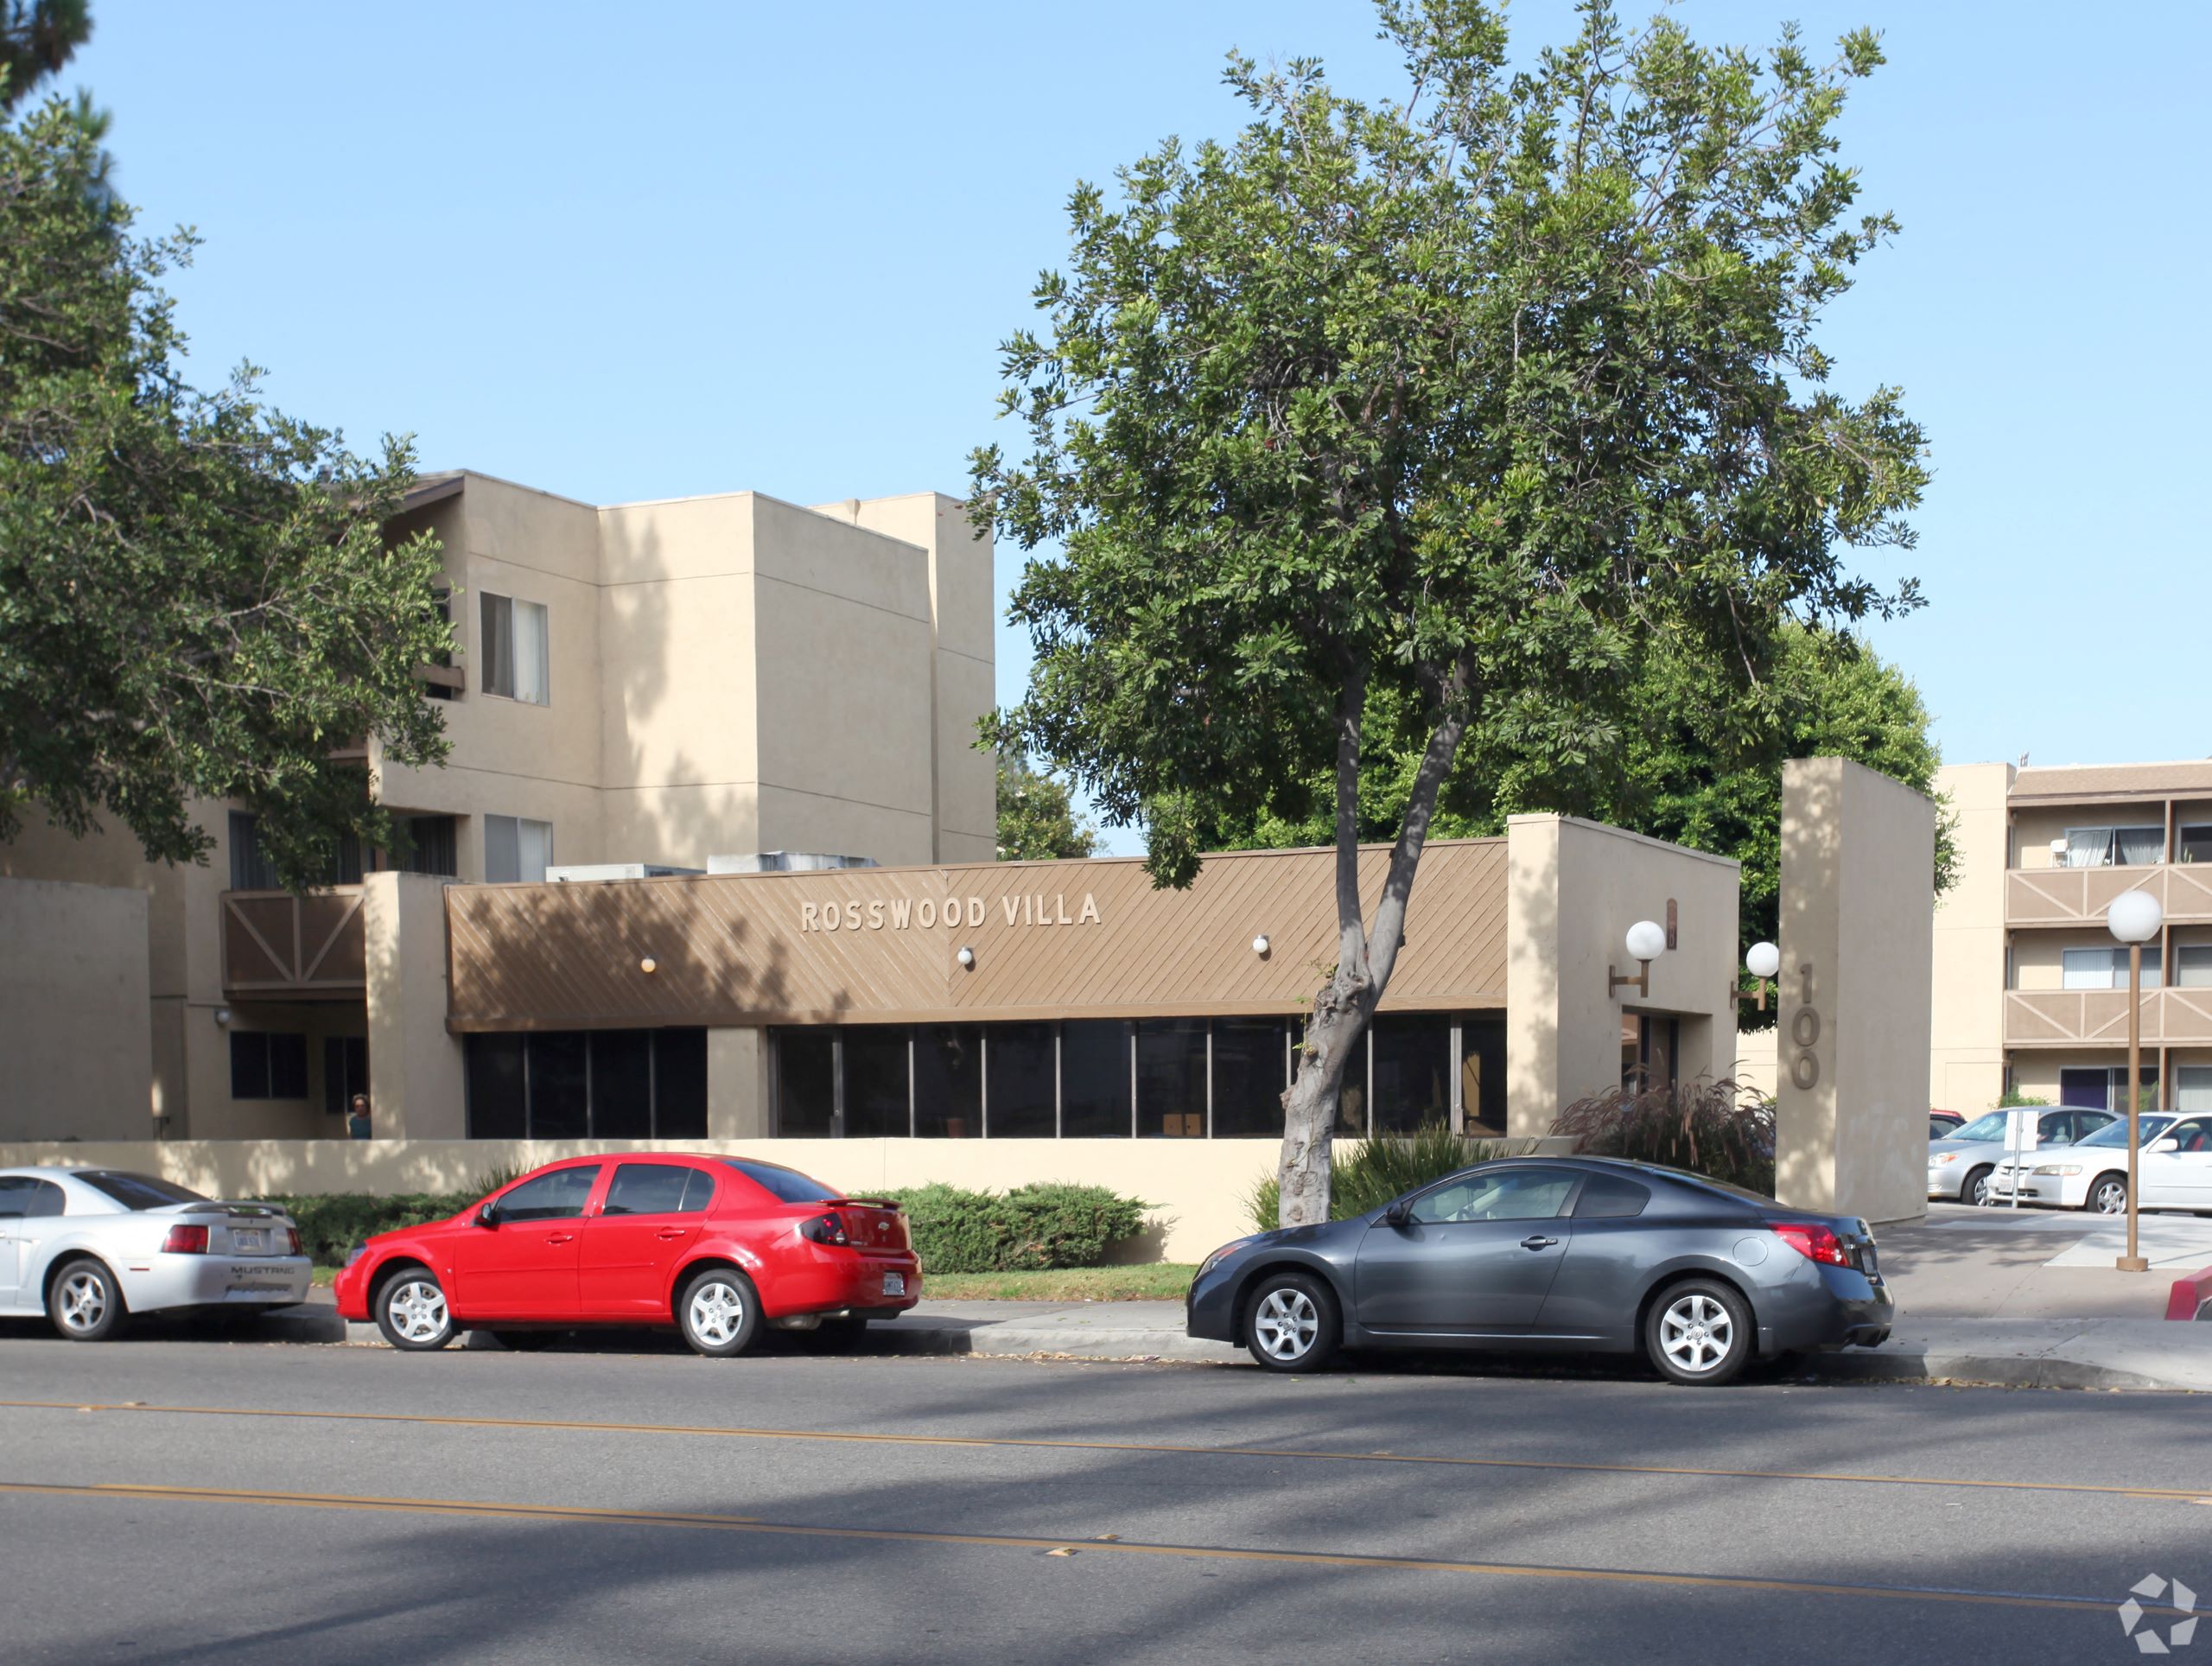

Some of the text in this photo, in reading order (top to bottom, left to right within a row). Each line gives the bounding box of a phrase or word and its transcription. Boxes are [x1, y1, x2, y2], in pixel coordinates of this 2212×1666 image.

[801, 892, 1102, 932] ROSSWOOD VILLA
[1791, 963, 1821, 1091] 100
[231, 1266, 295, 1275] MUSTANG
